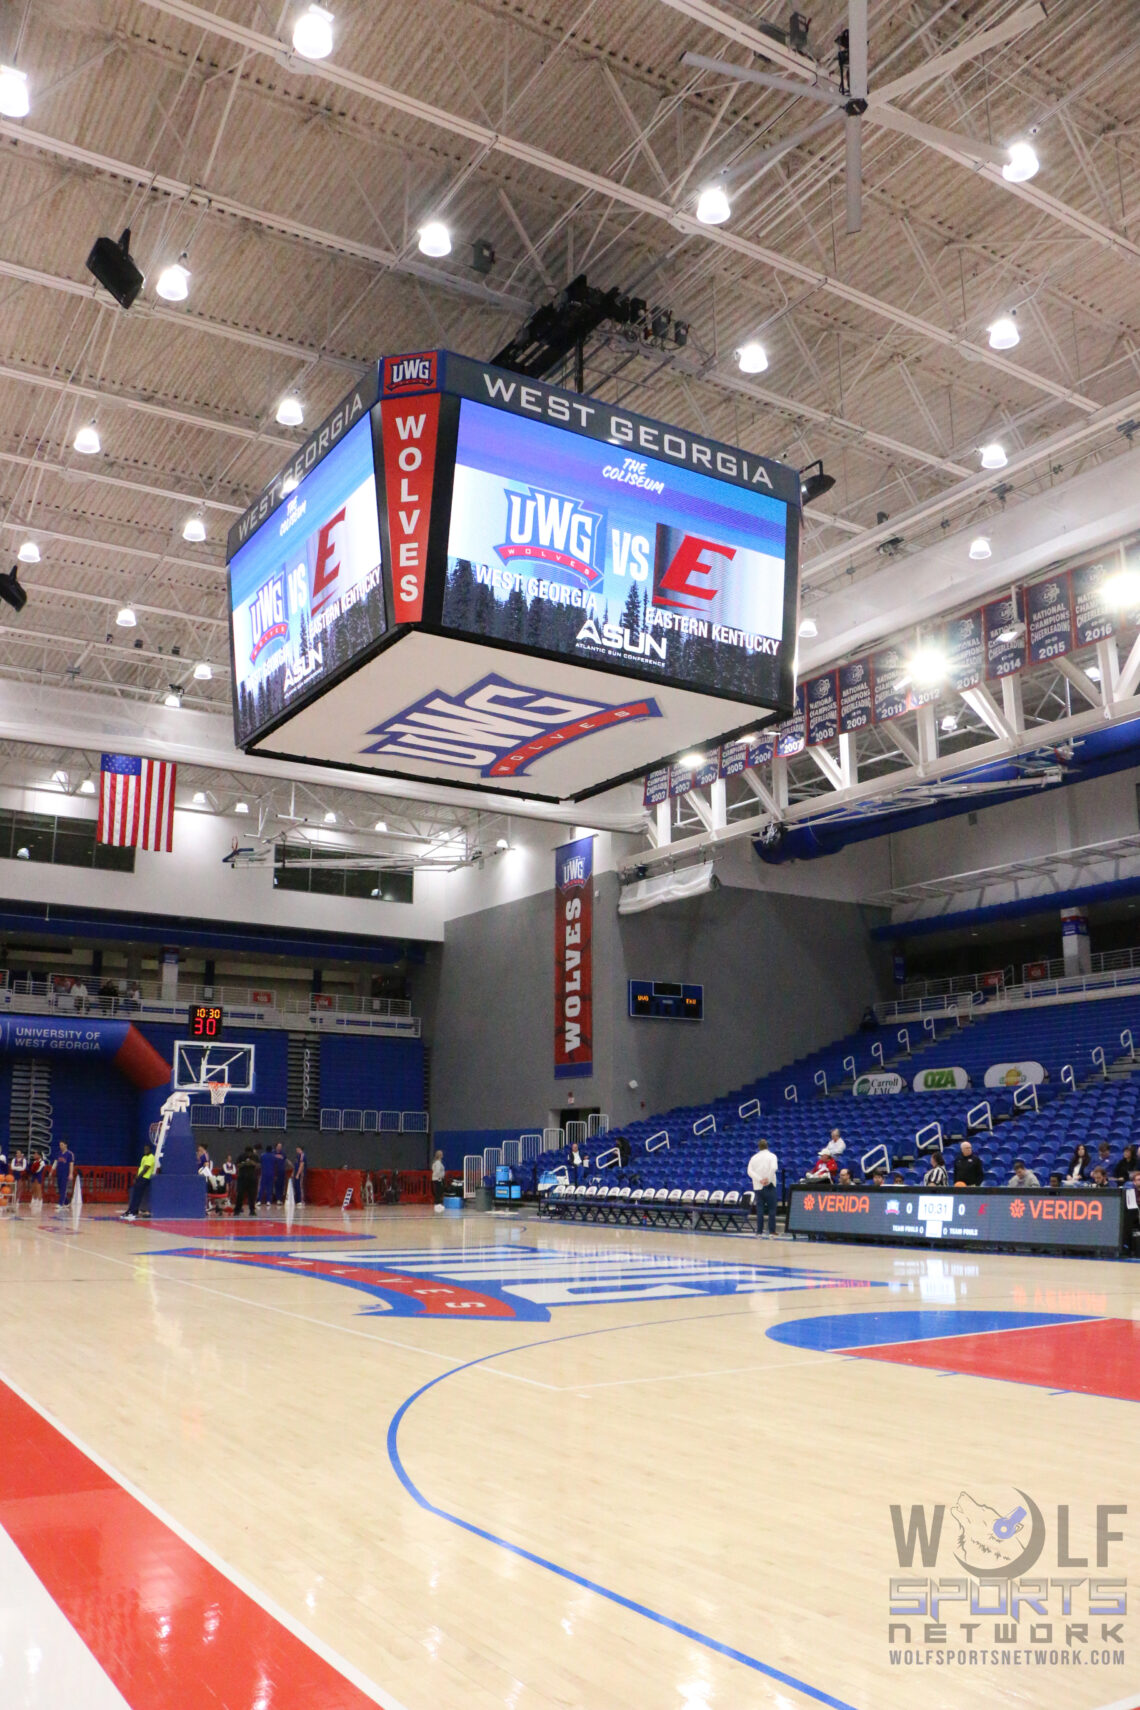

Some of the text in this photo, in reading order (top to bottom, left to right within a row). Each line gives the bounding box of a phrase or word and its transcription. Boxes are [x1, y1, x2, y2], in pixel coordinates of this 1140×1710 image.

[391, 358, 430, 382] UWG
[483, 374, 774, 489] WEST GEORGIA
[624, 458, 648, 475] THE
[602, 465, 665, 495] COLISEUM
[238, 482, 281, 541] WEST
[395, 414, 426, 602] WOLVES
[509, 492, 593, 564] UWG
[313, 506, 347, 599] E
[507, 546, 591, 576] WOLVES
[611, 528, 649, 581] VS
[659, 534, 737, 601] E
[288, 562, 307, 615] VS
[341, 565, 381, 613] KENTUCKY
[476, 563, 599, 610] WEST GEORGIA
[251, 580, 283, 645] UWG
[1030, 611, 1070, 631] CHAMPIONS
[1033, 603, 1066, 621] NATIONAL
[576, 619, 667, 660] ASUN
[645, 607, 780, 656] EASTERN KENTUCKY
[1085, 623, 1112, 642] 2016
[576, 643, 606, 654] ATLANTIC
[623, 653, 666, 667] CONFERENCE
[1039, 641, 1066, 659] 2015
[283, 642, 323, 692] ASUN
[996, 658, 1021, 675] 2014
[842, 682, 869, 697] NATIONAL
[918, 688, 940, 705] 2012
[846, 714, 867, 729] 2009
[881, 703, 903, 719] 2011
[377, 684, 605, 767] UWG
[815, 727, 834, 742] 2008
[726, 762, 743, 775] 2005
[563, 858, 585, 882] UWG
[565, 898, 581, 1053] WOLVES
[197, 1008, 220, 1018] 10:30
[16, 1027, 101, 1040] UNIVERSITY OF
[194, 1017, 216, 1035] 30
[15, 1038, 101, 1050] WEST GEORGIA
[871, 1078, 898, 1088] Carroll
[924, 1070, 956, 1088] OZA
[818, 1194, 870, 1213] VERIDA
[906, 1202, 913, 1214] 0
[958, 1203, 965, 1216] 0
[1029, 1199, 1103, 1221] VERIDA
